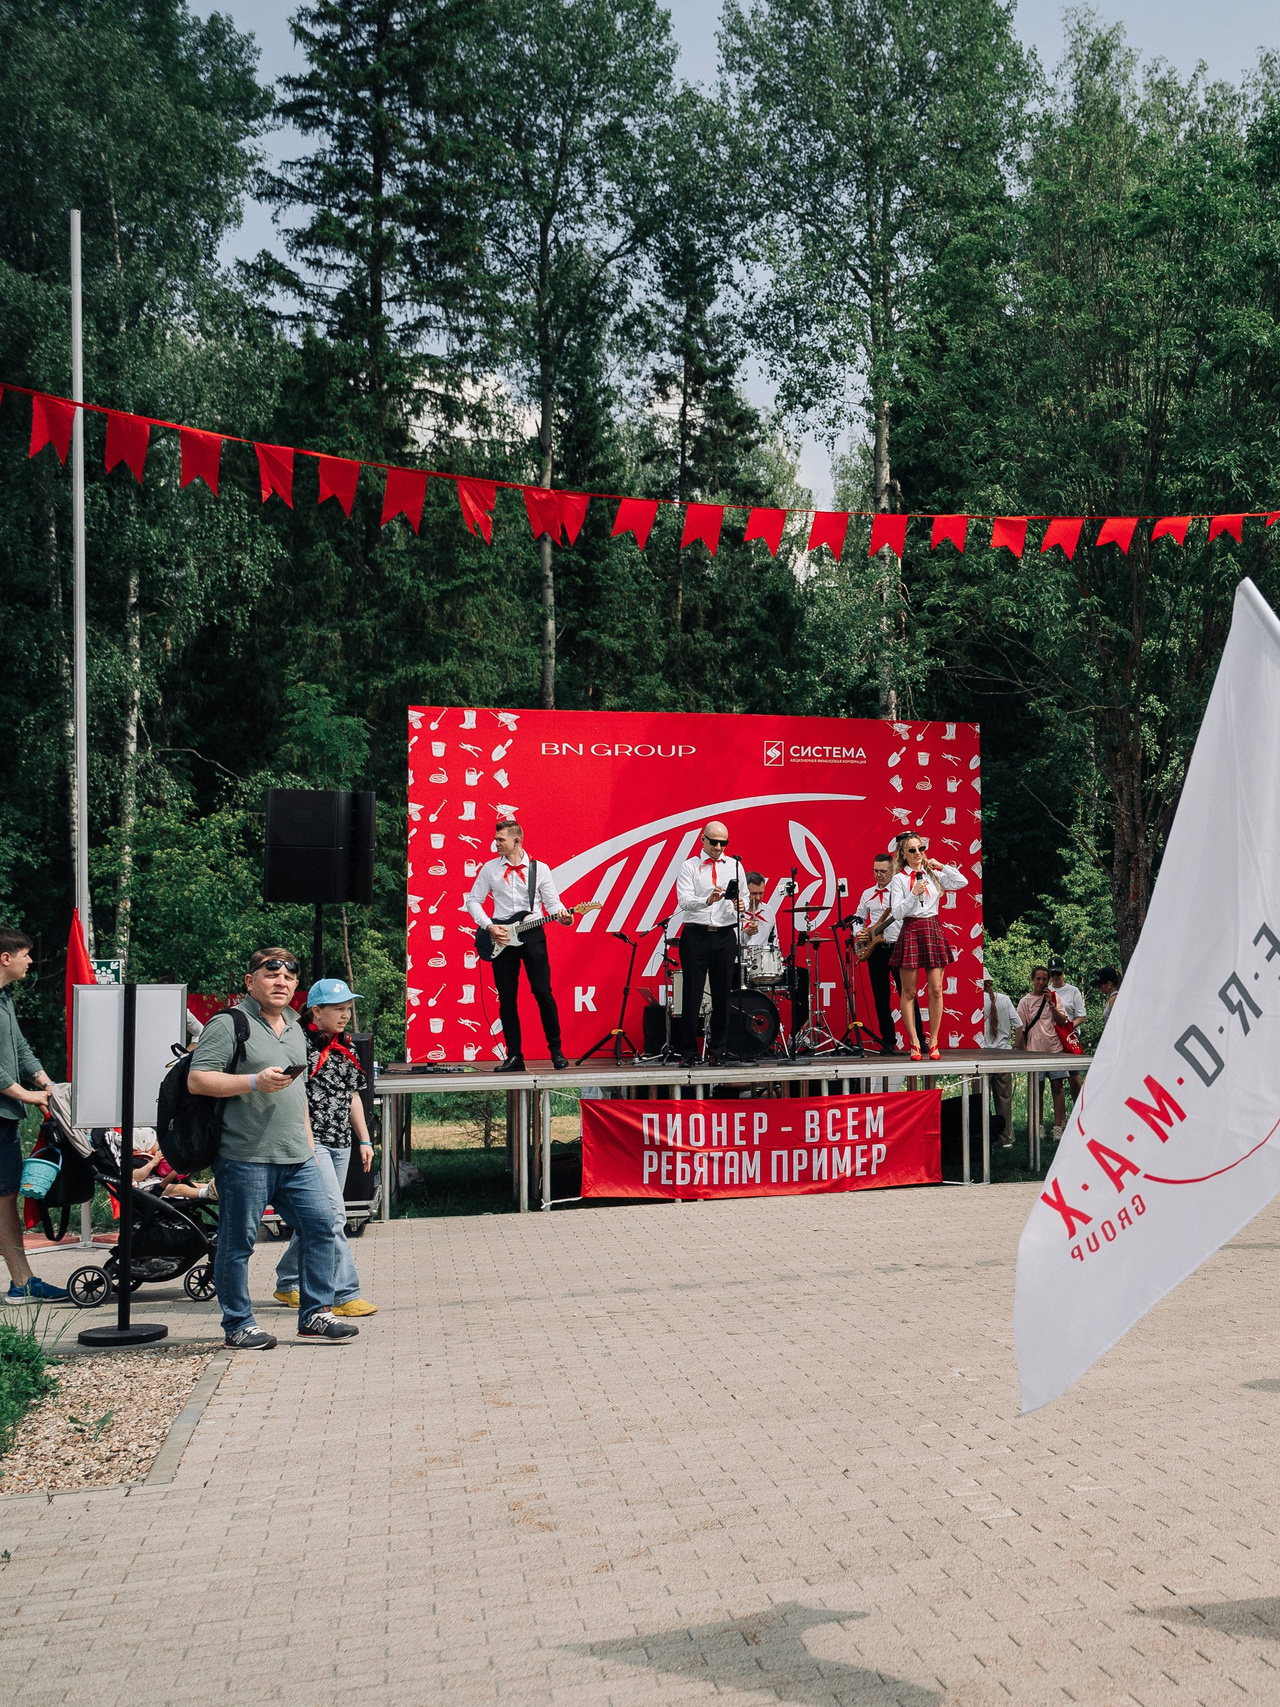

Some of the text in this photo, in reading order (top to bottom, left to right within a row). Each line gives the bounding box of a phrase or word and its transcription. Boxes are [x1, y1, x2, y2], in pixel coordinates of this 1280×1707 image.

[541, 742, 697, 757] BN GROUP
[789, 745, 867, 759] СИСТЕМА
[642, 1112, 768, 1147] ПИОНЕР
[805, 1105, 884, 1143] ВСЕМ
[642, 1143, 887, 1186] РЕБЯТАМ ПРИМЕР
